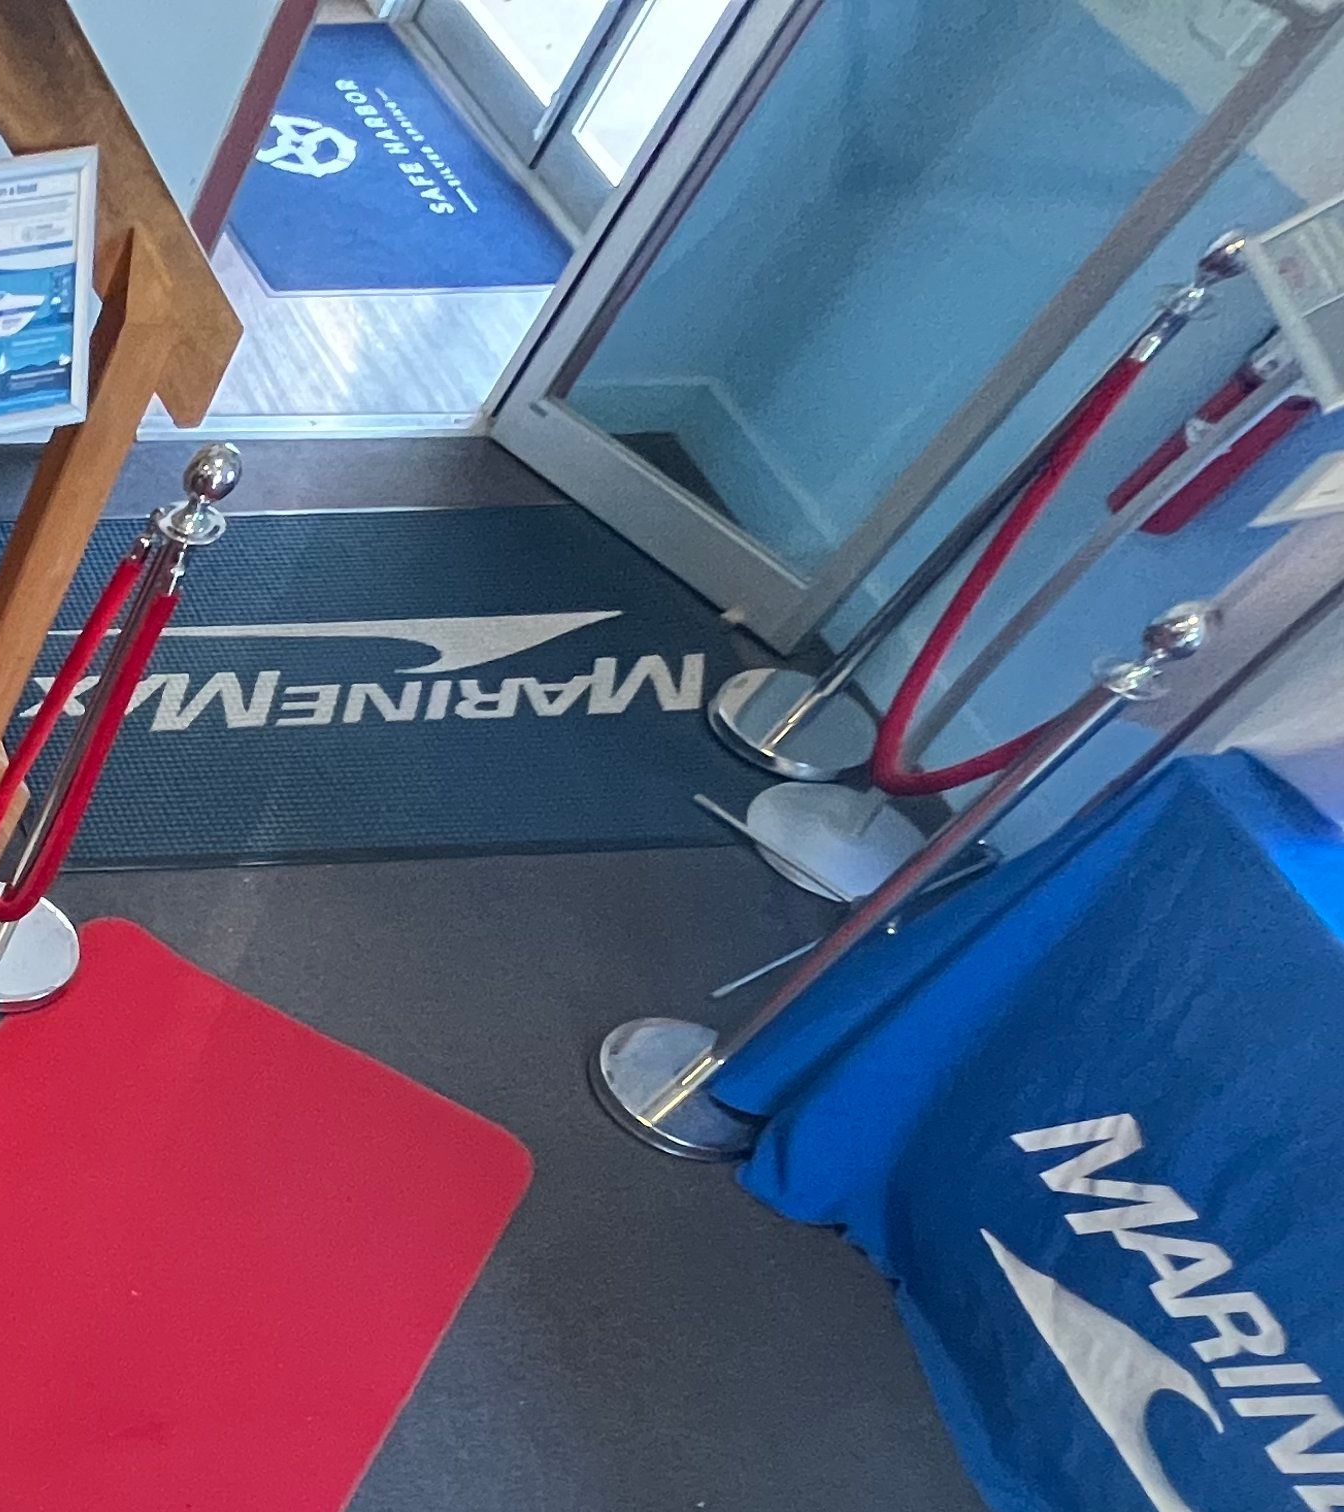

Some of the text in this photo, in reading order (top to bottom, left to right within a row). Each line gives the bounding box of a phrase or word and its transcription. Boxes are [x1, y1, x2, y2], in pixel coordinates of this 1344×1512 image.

[334, 78, 455, 215] SAFE HARBOR
[18, 652, 705, 732] MARINEMX
